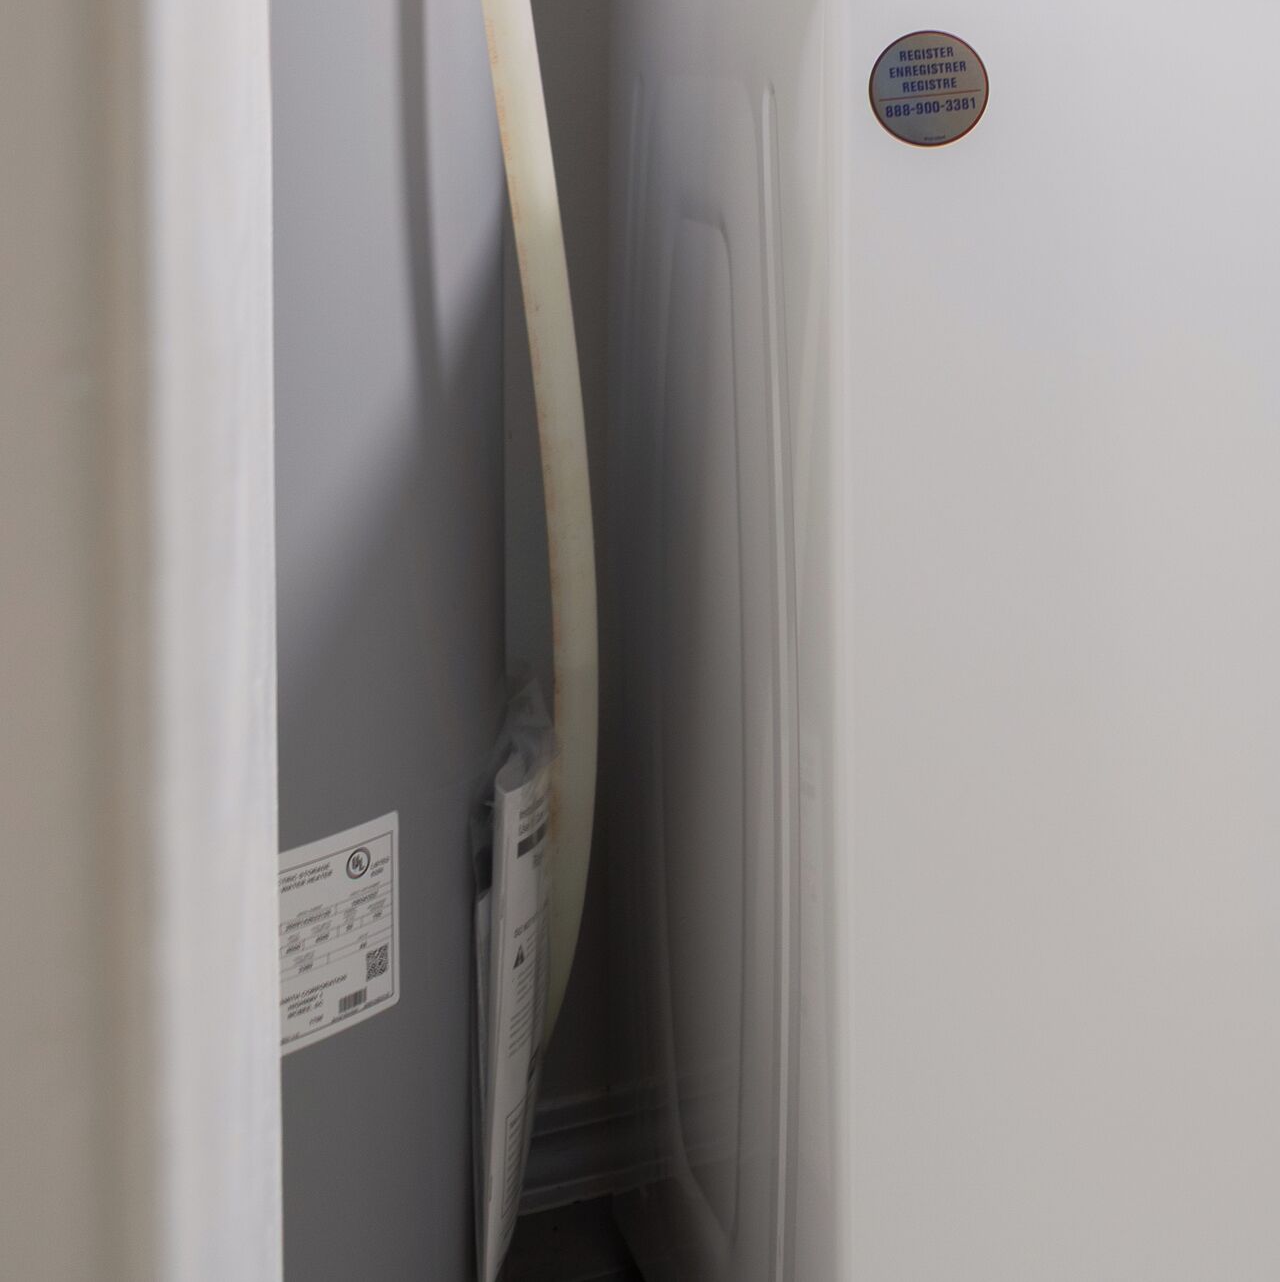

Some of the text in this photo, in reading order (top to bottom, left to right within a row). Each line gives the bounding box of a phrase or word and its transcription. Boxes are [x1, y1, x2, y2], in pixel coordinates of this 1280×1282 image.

[900, 46, 954, 61] REGISTER
[889, 61, 967, 79] ENREGISTRER
[902, 77, 957, 93] REGISTRE
[885, 97, 977, 118] 888-900-3381
